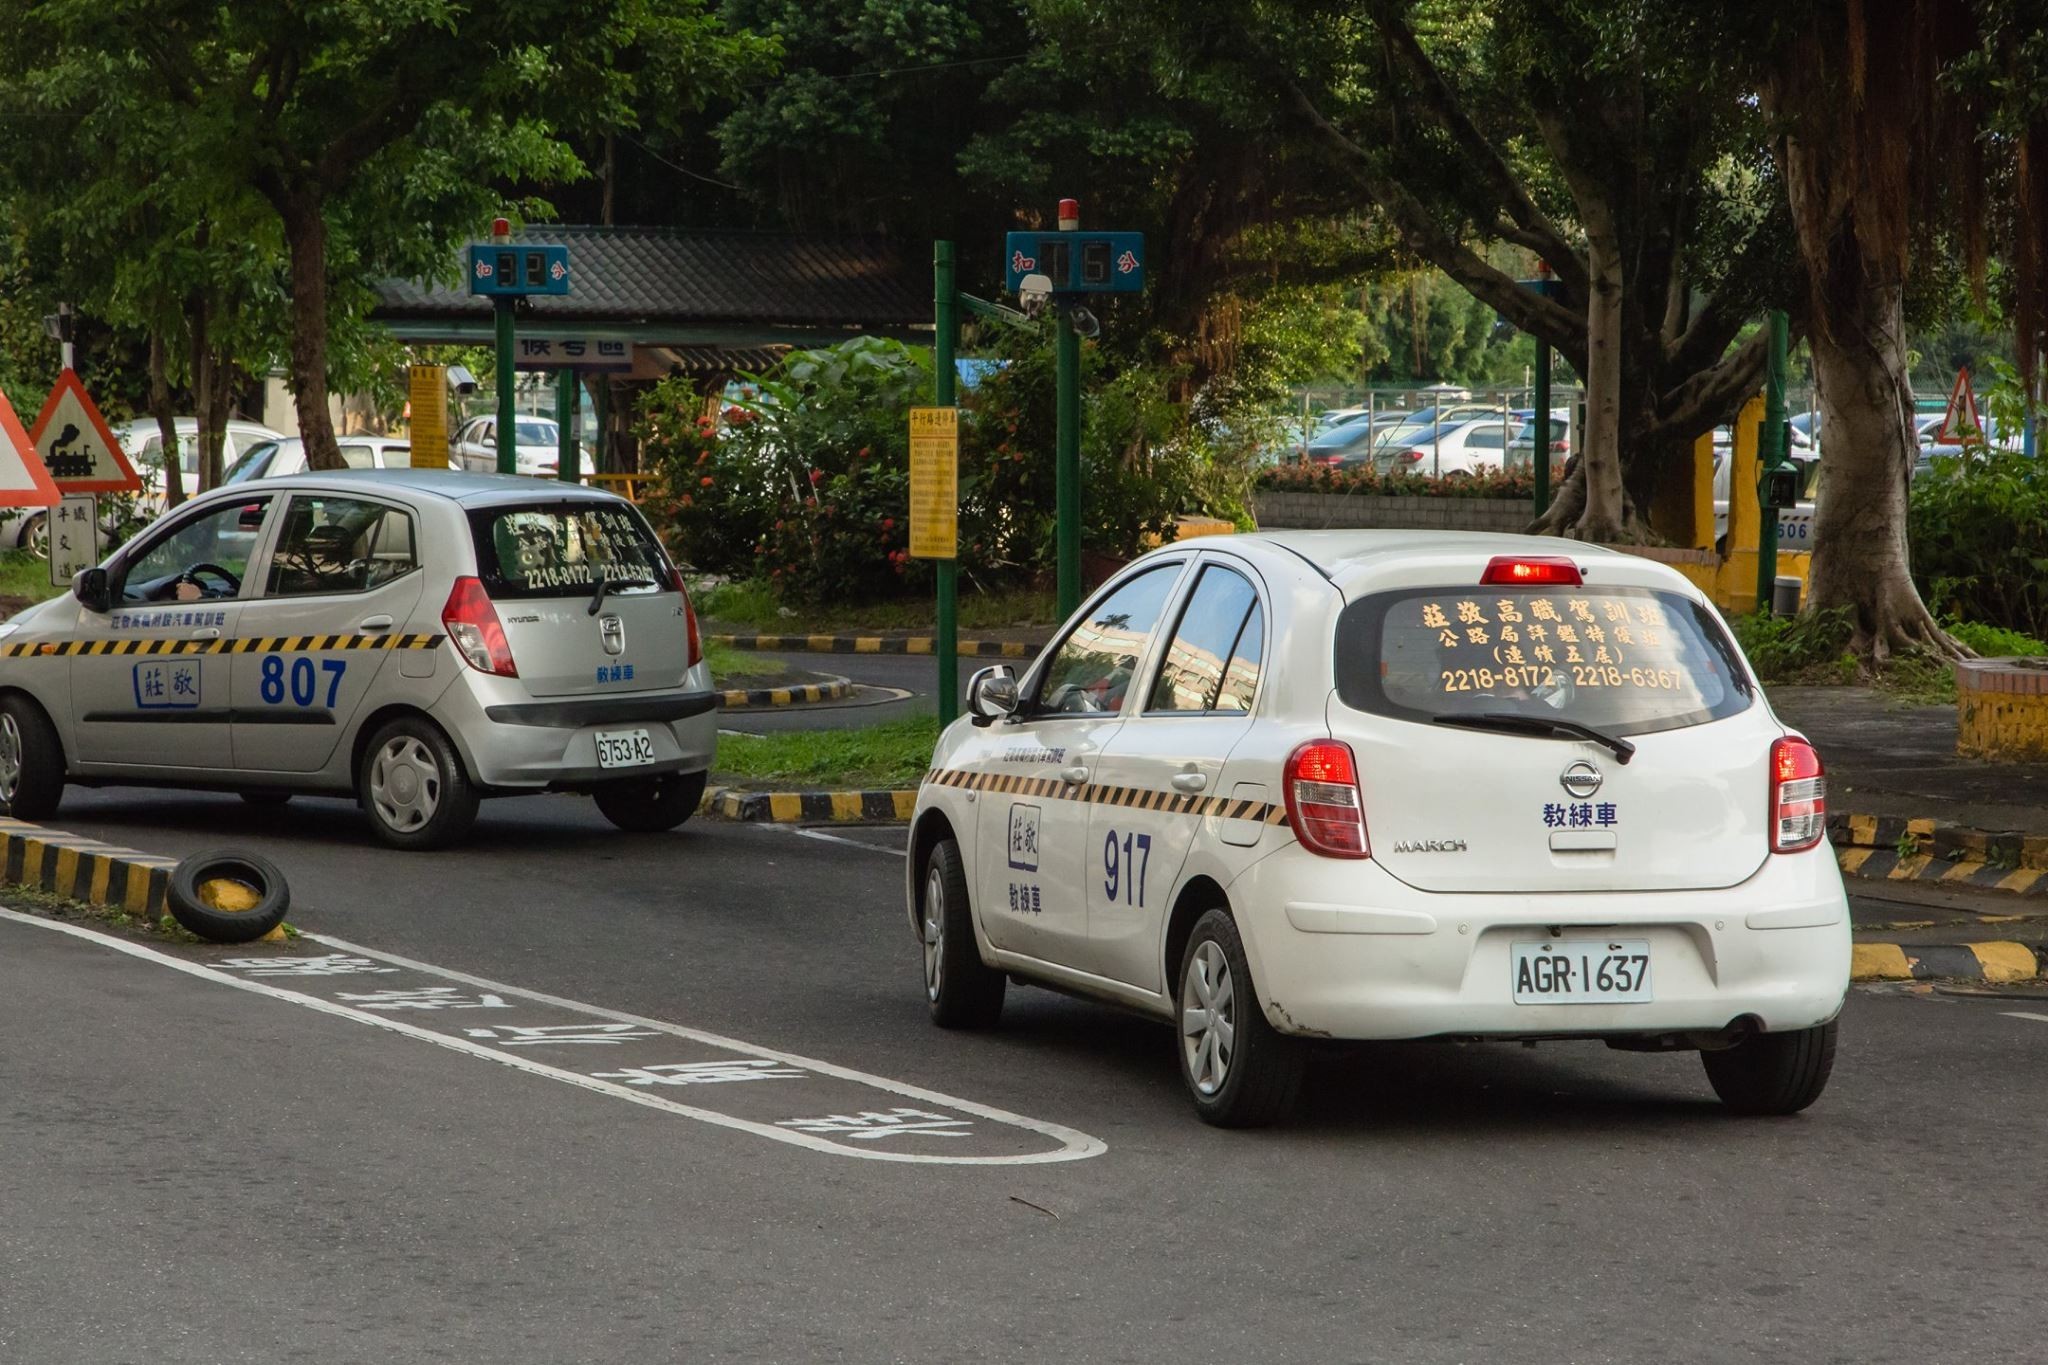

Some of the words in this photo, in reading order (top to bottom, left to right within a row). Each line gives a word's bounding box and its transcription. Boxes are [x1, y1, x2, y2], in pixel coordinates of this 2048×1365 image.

[475, 259, 493, 279] 扣
[550, 260, 567, 280] 分
[1012, 250, 1036, 273] 扣
[1116, 250, 1140, 274] 分
[525, 565, 594, 589] 2218-8172
[1423, 599, 1665, 628] 莊敬高職駕訓班
[1439, 625, 1661, 648] 公路局評鑑特優班
[144, 665, 196, 697] 莊敬
[260, 655, 346, 709] 807
[1441, 665, 1556, 693] 2218-8172
[1572, 664, 1682, 690] 2218-6367
[1564, 775, 1601, 784] NISSAN
[1013, 816, 1037, 854] 莊敬
[1394, 839, 1467, 854] MARCH
[1104, 829, 1152, 908] 917
